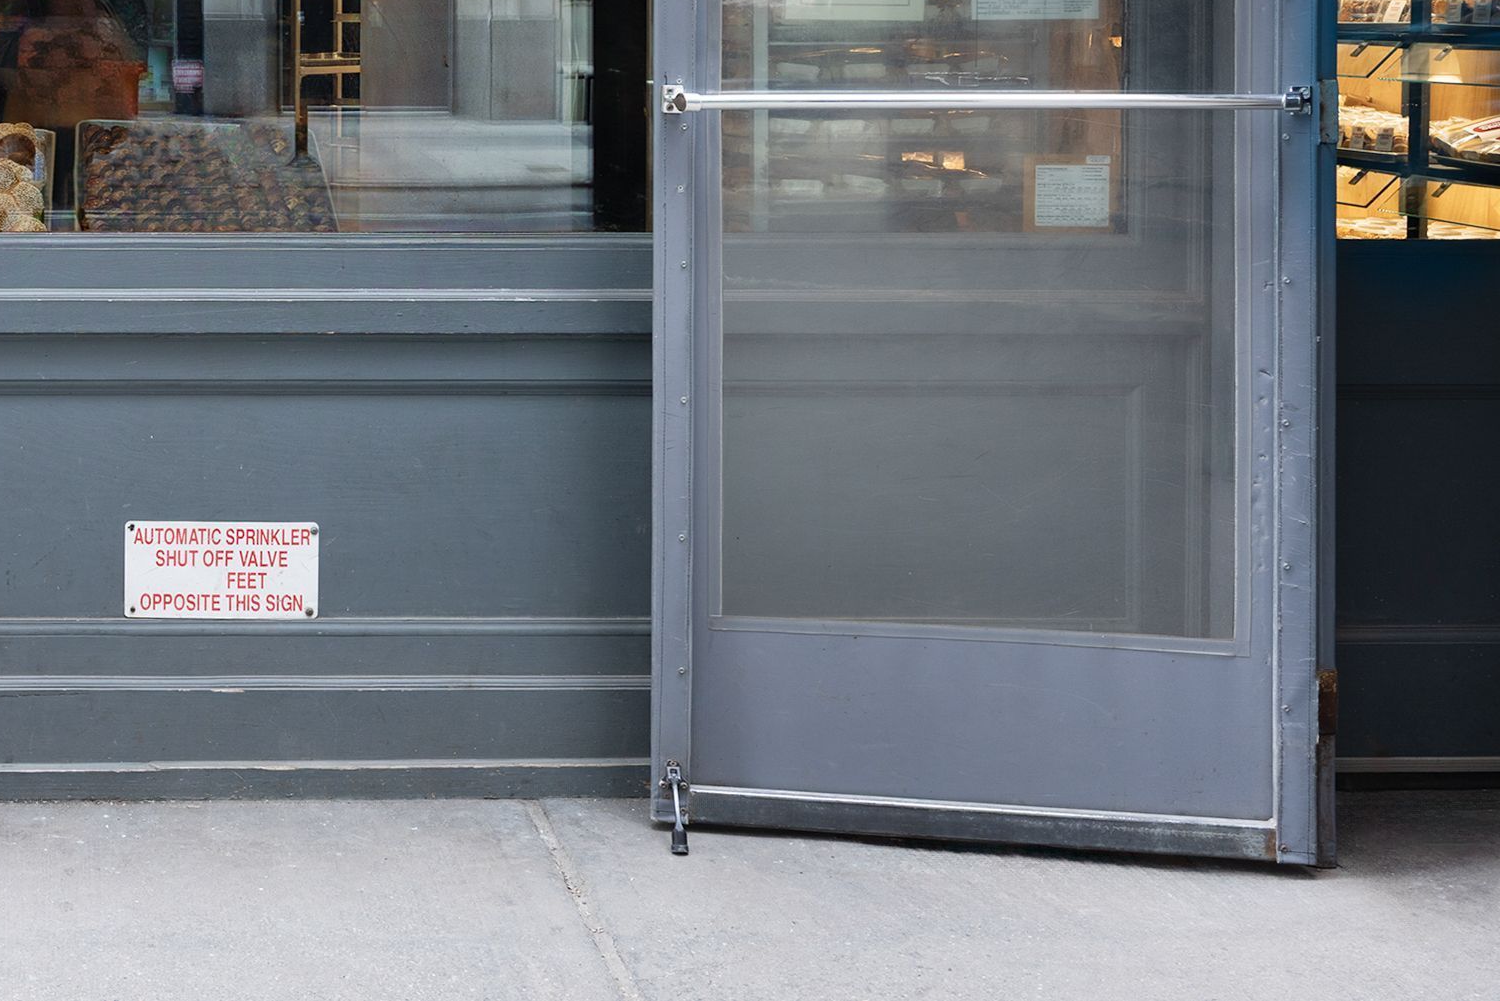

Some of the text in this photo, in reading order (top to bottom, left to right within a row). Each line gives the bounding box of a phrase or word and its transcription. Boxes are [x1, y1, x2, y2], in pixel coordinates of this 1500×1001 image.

[133, 527, 311, 546] AUTOMATIC SPRINKLER
[155, 549, 288, 567] SHUT OFF VALVE
[227, 572, 267, 589] FEET
[140, 593, 303, 612] OPPOSITE THIS SIGN
